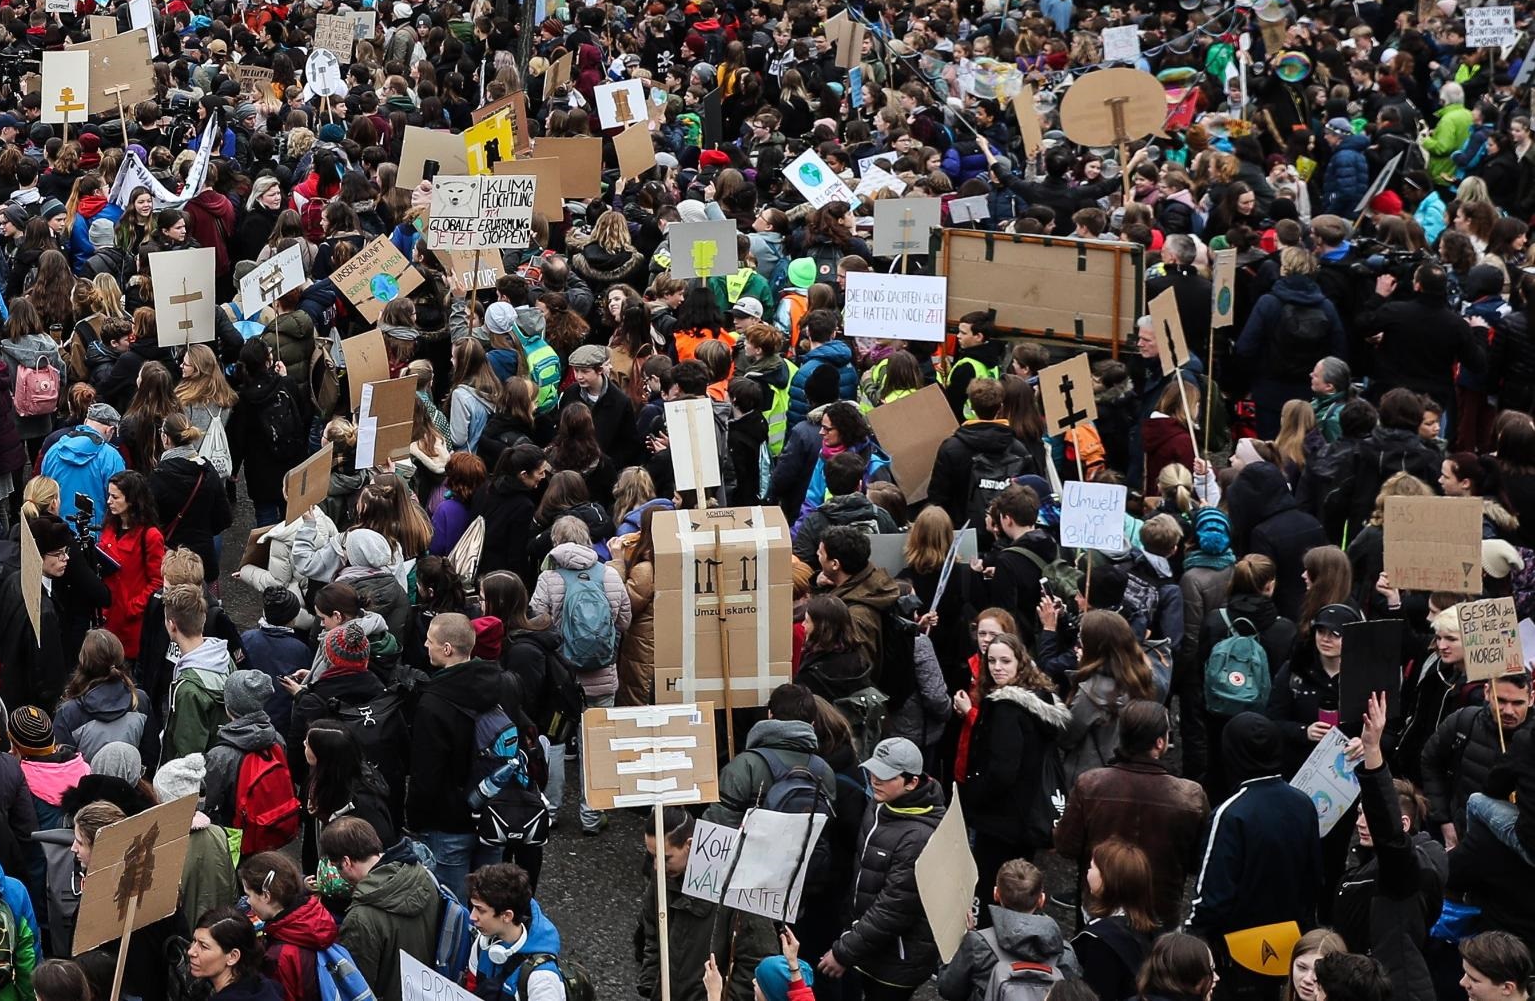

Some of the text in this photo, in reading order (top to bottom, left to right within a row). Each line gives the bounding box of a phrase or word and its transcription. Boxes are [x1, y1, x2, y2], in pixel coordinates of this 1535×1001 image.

[486, 179, 534, 194] KLIMA
[430, 219, 474, 232] GLOBALE
[434, 229, 531, 247] JETZT STOPPEN!
[334, 241, 385, 283] UNSERE ZUKUNFT
[380, 254, 402, 273] FADEN
[847, 288, 861, 301] DIE
[887, 290, 922, 304] DACHTEN
[846, 305, 861, 319] SIE
[925, 308, 943, 324] ZEIT
[979, 478, 995, 489] JUST
[1068, 485, 1119, 512] Umwelt
[705, 509, 735, 518] ACHTUNG
[1087, 514, 1106, 527] vor
[1064, 525, 1122, 550] Bildung
[694, 605, 756, 617] Umzuskarto
[1465, 634, 1501, 648] WALD und
[1469, 647, 1504, 665] MORGEN
